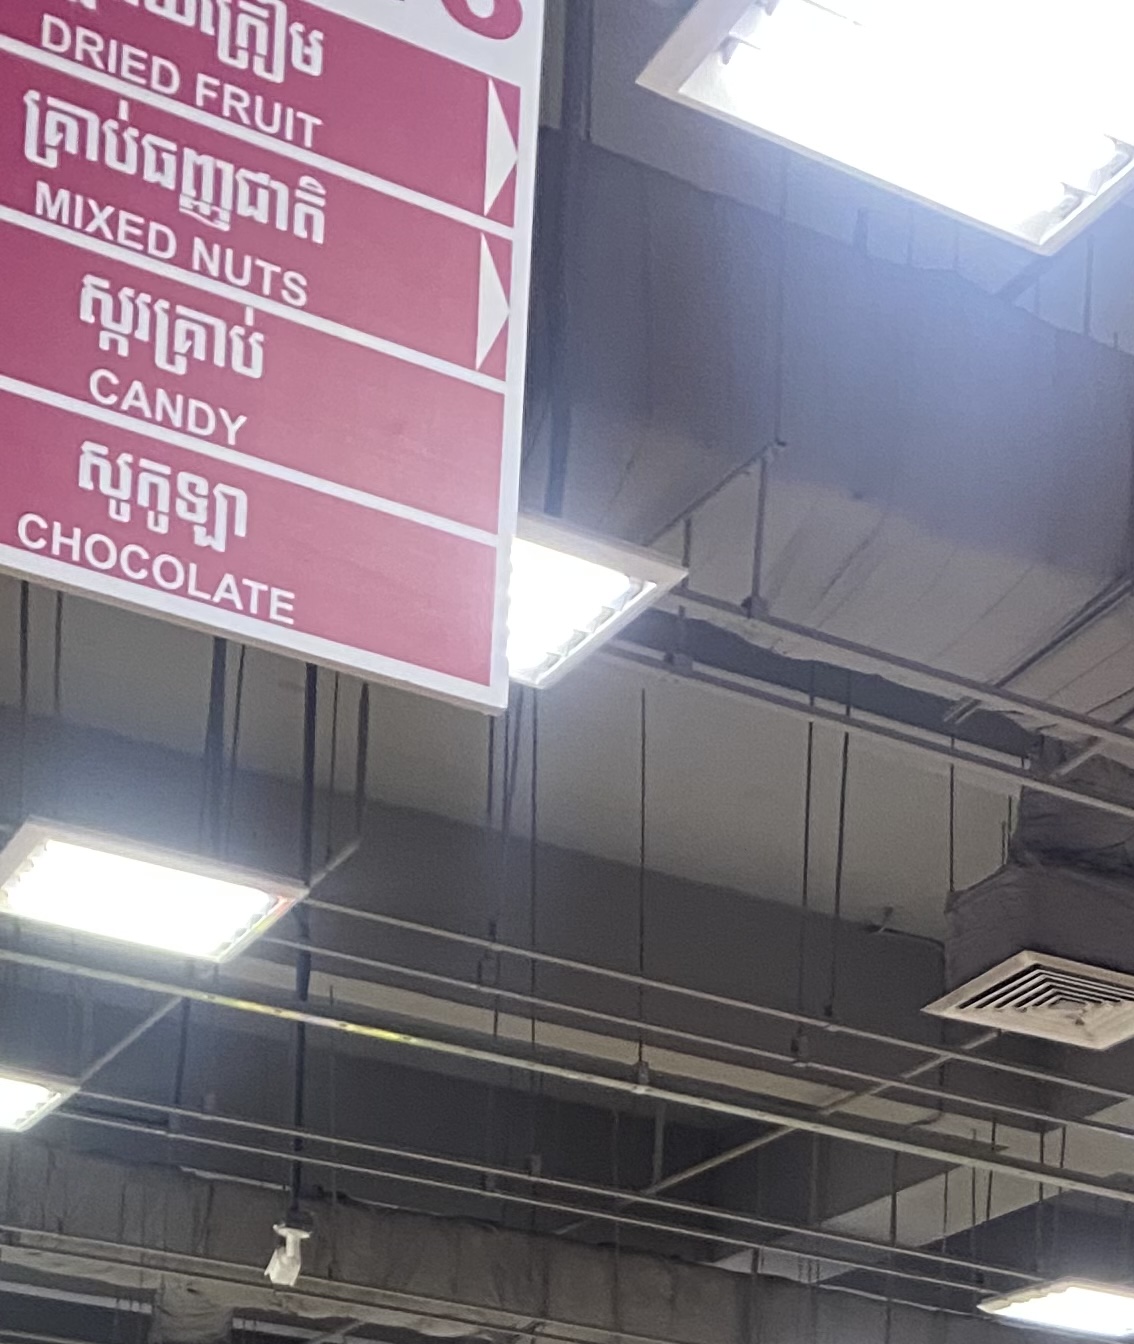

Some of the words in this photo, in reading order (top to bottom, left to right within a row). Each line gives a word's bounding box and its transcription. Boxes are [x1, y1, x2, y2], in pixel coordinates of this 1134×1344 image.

[41, 13, 181, 95] DRIED
[195, 72, 324, 148] FRUIT
[35, 181, 177, 260] MIXED
[191, 236, 309, 307] NUTS
[79, 273, 266, 379] ស្ករគ្រាប់
[89, 369, 248, 446] CANDY
[78, 440, 248, 553] សូកូឡា
[17, 513, 296, 626] CHOCOLATE
